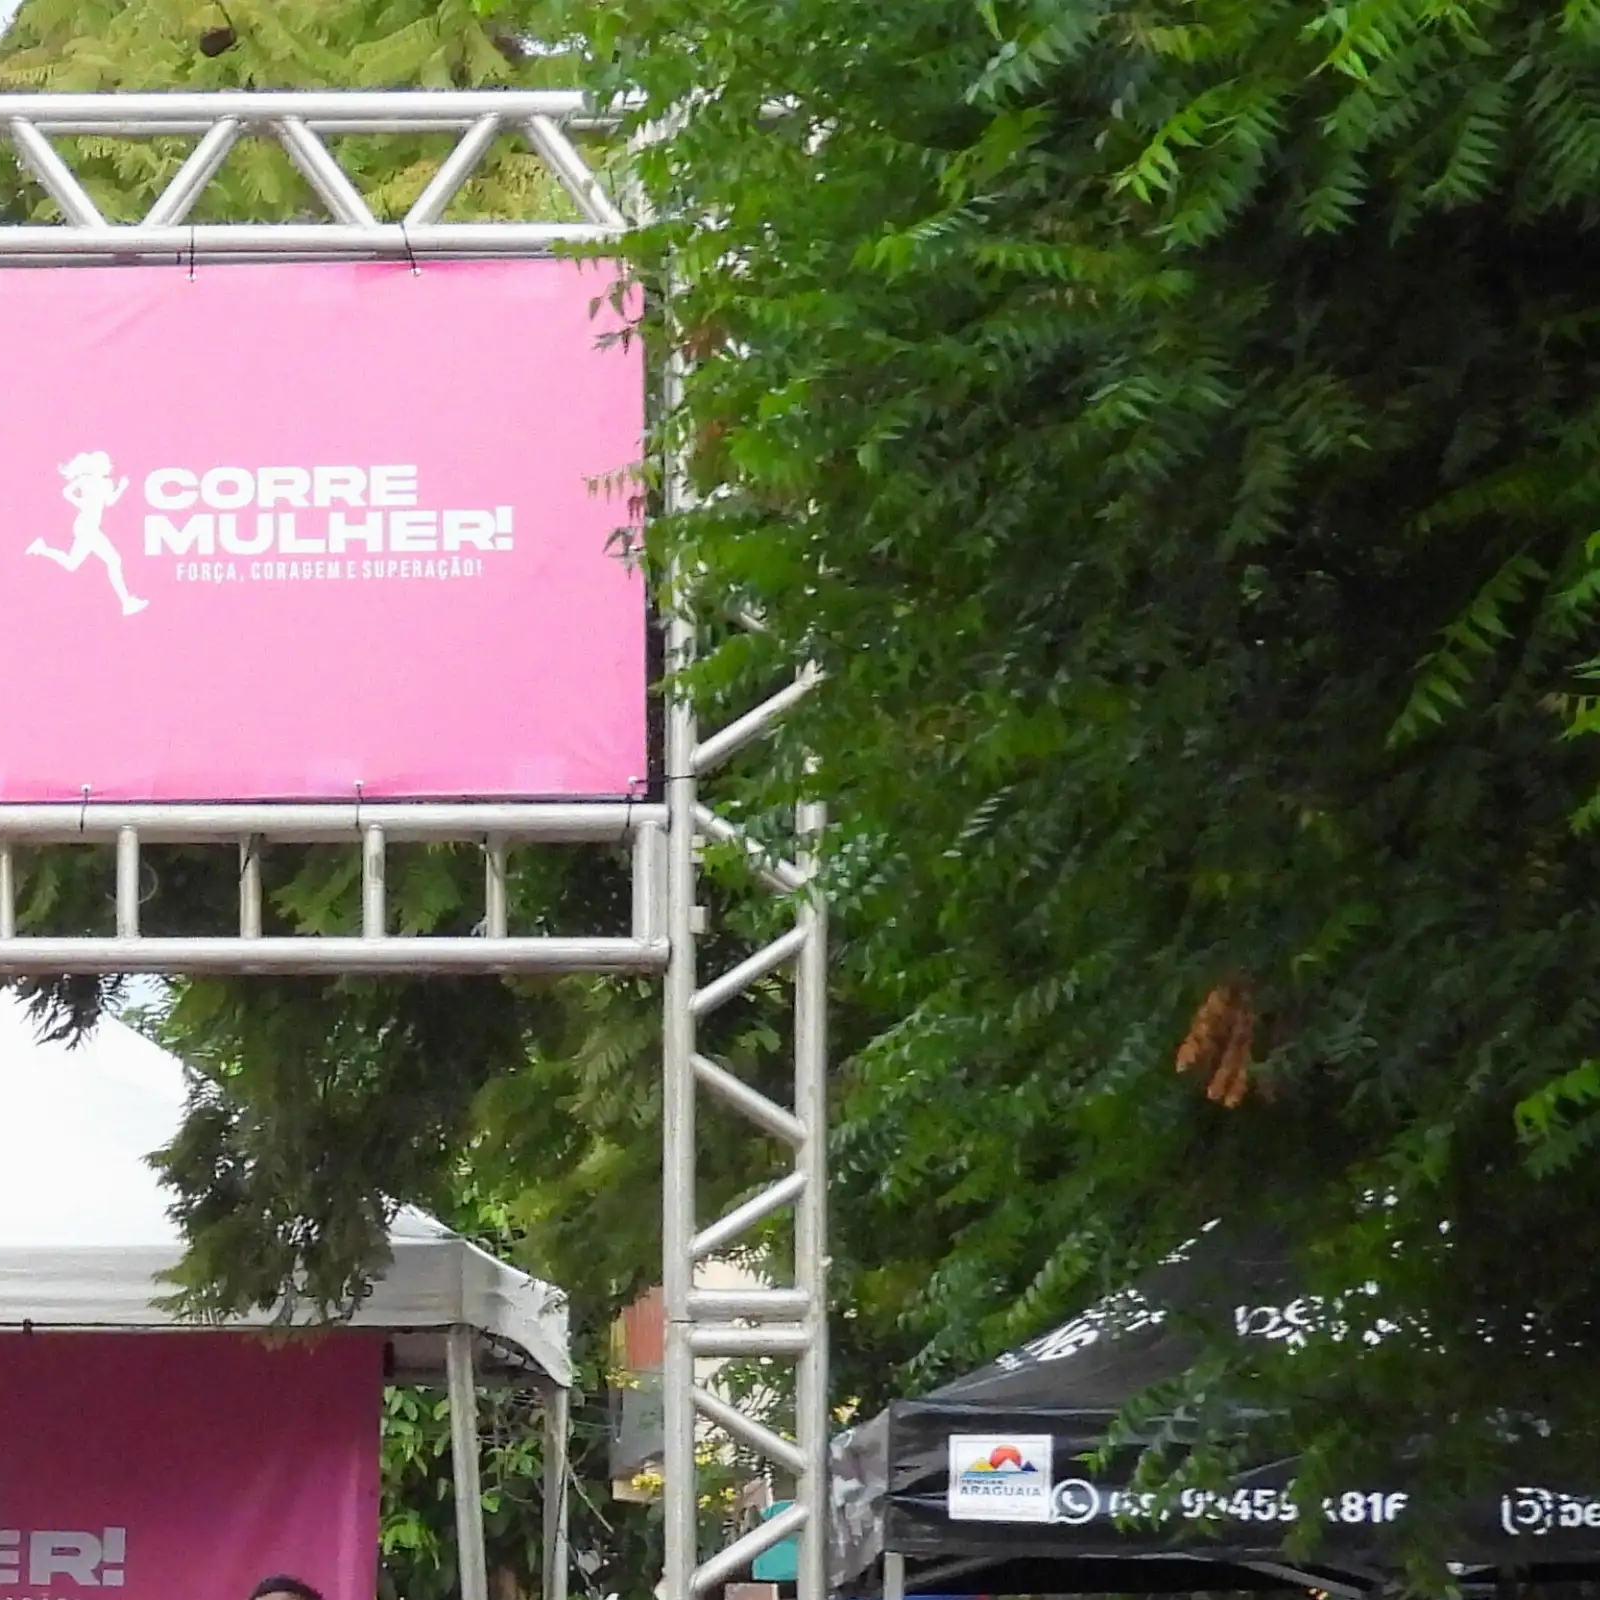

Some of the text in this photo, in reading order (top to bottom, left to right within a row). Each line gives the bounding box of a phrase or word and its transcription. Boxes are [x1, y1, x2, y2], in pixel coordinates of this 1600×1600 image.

[144, 464, 418, 510] CORRE
[144, 505, 514, 556] MULHER!
[176, 556, 483, 584] FORÇA, CORAGEM E SUPERAÇÃO!
[960, 1485, 1041, 1497] ARAGUAIA
